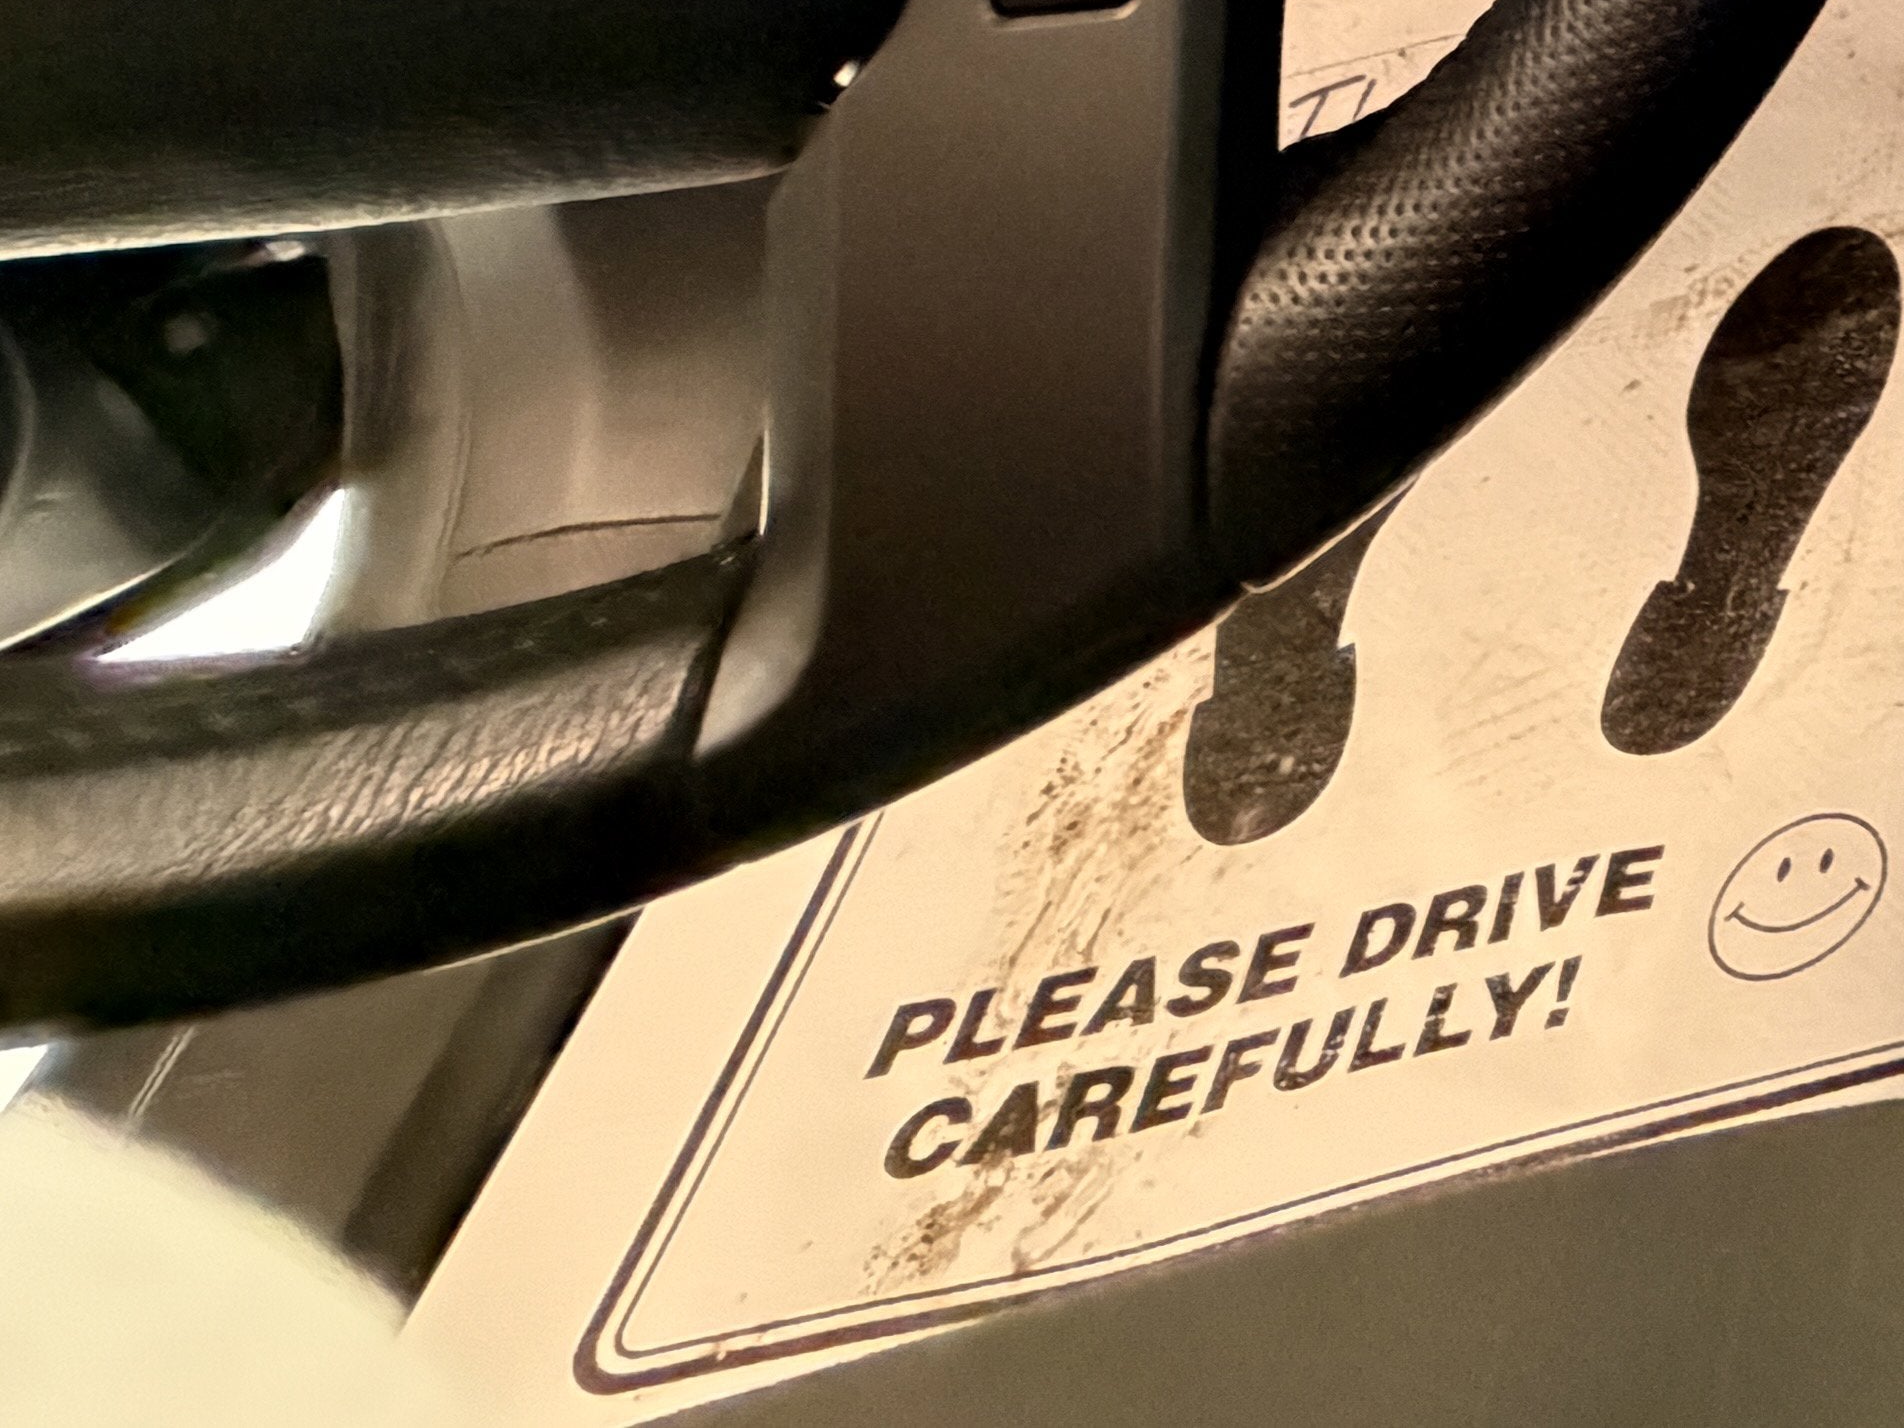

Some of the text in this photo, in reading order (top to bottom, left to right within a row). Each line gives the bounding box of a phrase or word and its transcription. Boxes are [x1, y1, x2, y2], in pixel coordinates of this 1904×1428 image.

[865, 844, 1665, 1081] PLEASE DRIVE
[883, 956, 1583, 1182] CAREFULLY!
